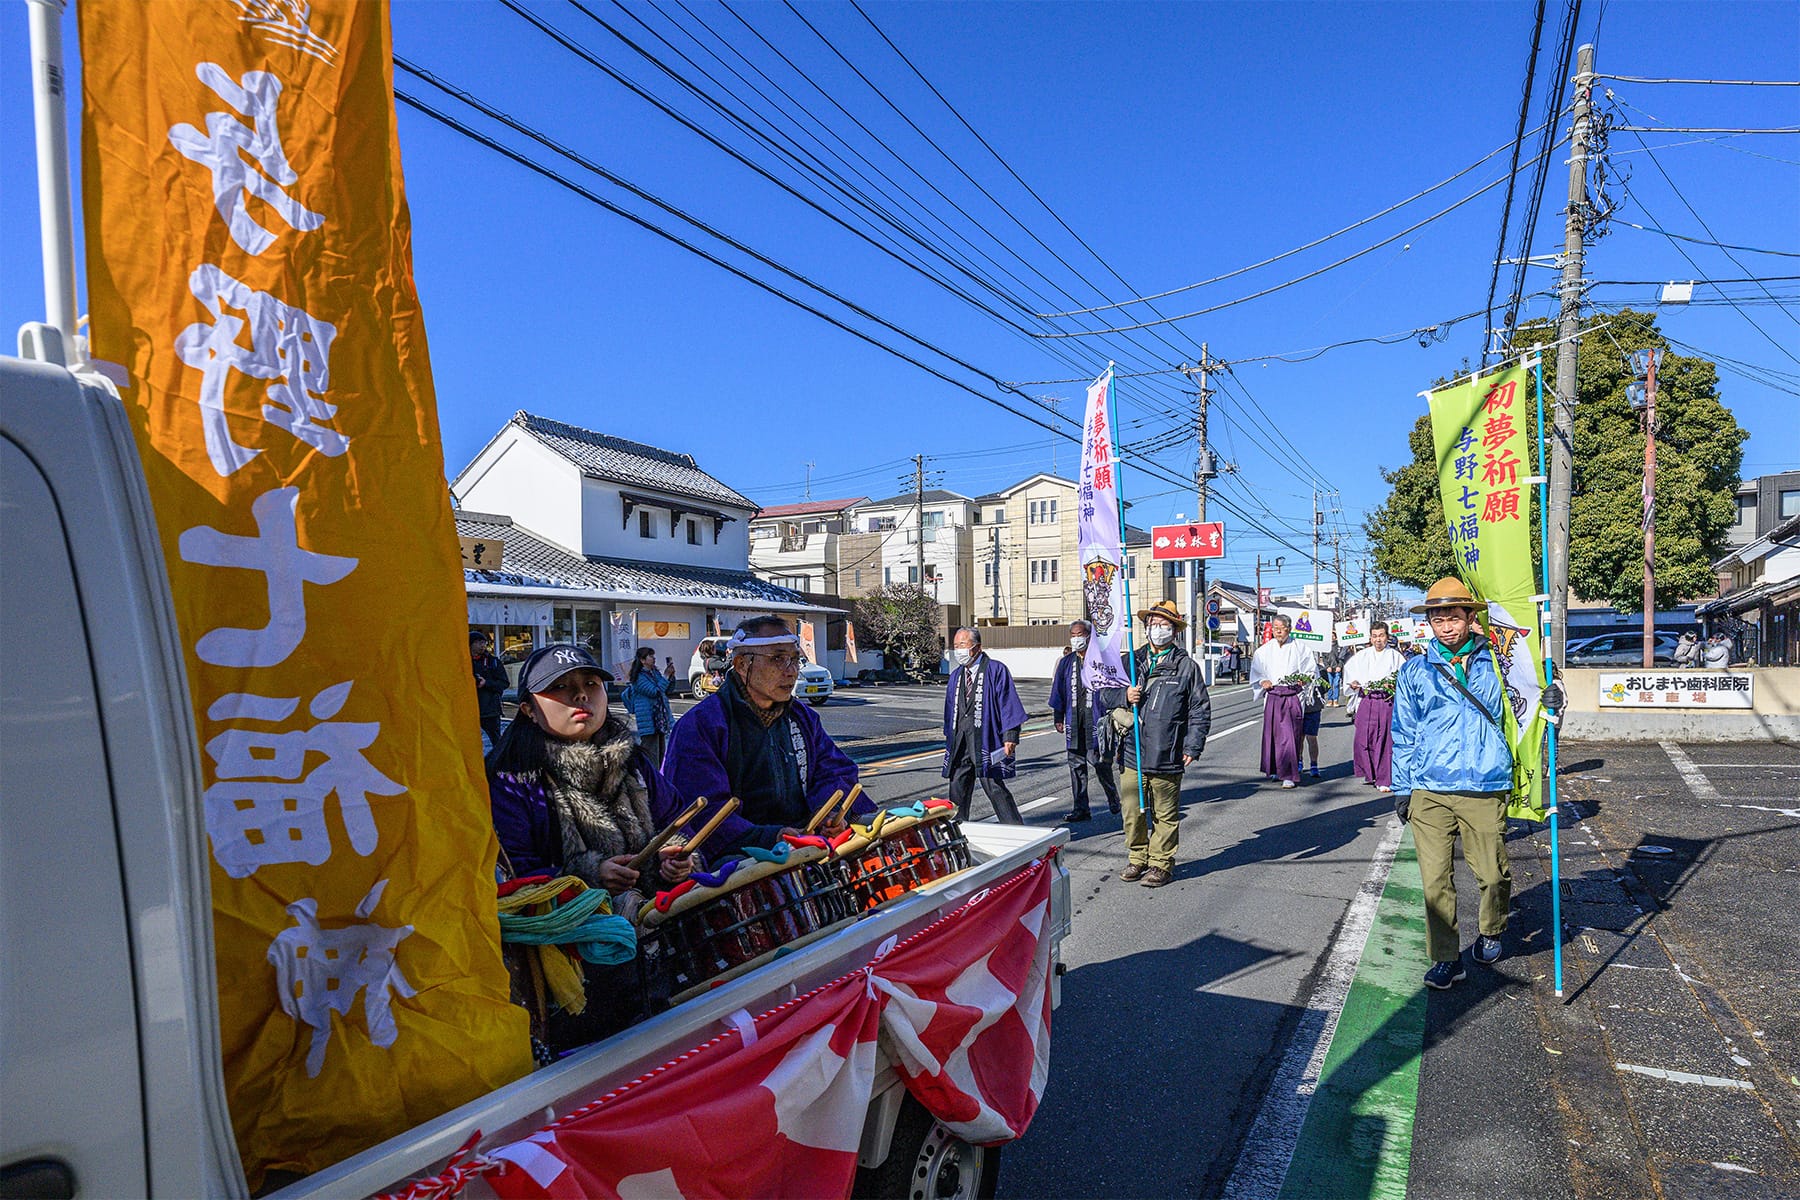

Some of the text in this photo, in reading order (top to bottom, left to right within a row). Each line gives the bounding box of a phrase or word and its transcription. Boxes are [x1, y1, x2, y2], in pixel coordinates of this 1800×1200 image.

[1094, 386, 1113, 490] 初夢祈願
[1481, 380, 1521, 524] 初夢祈願
[1082, 416, 1095, 523] 与野七福神
[1454, 427, 1480, 572] 与野七福神
[1174, 531, 1221, 549] 梅林堂
[554, 649, 580, 664] NY
[1626, 676, 1750, 691] おじまや歯科医院
[1638, 691, 1707, 704] 駐車場
